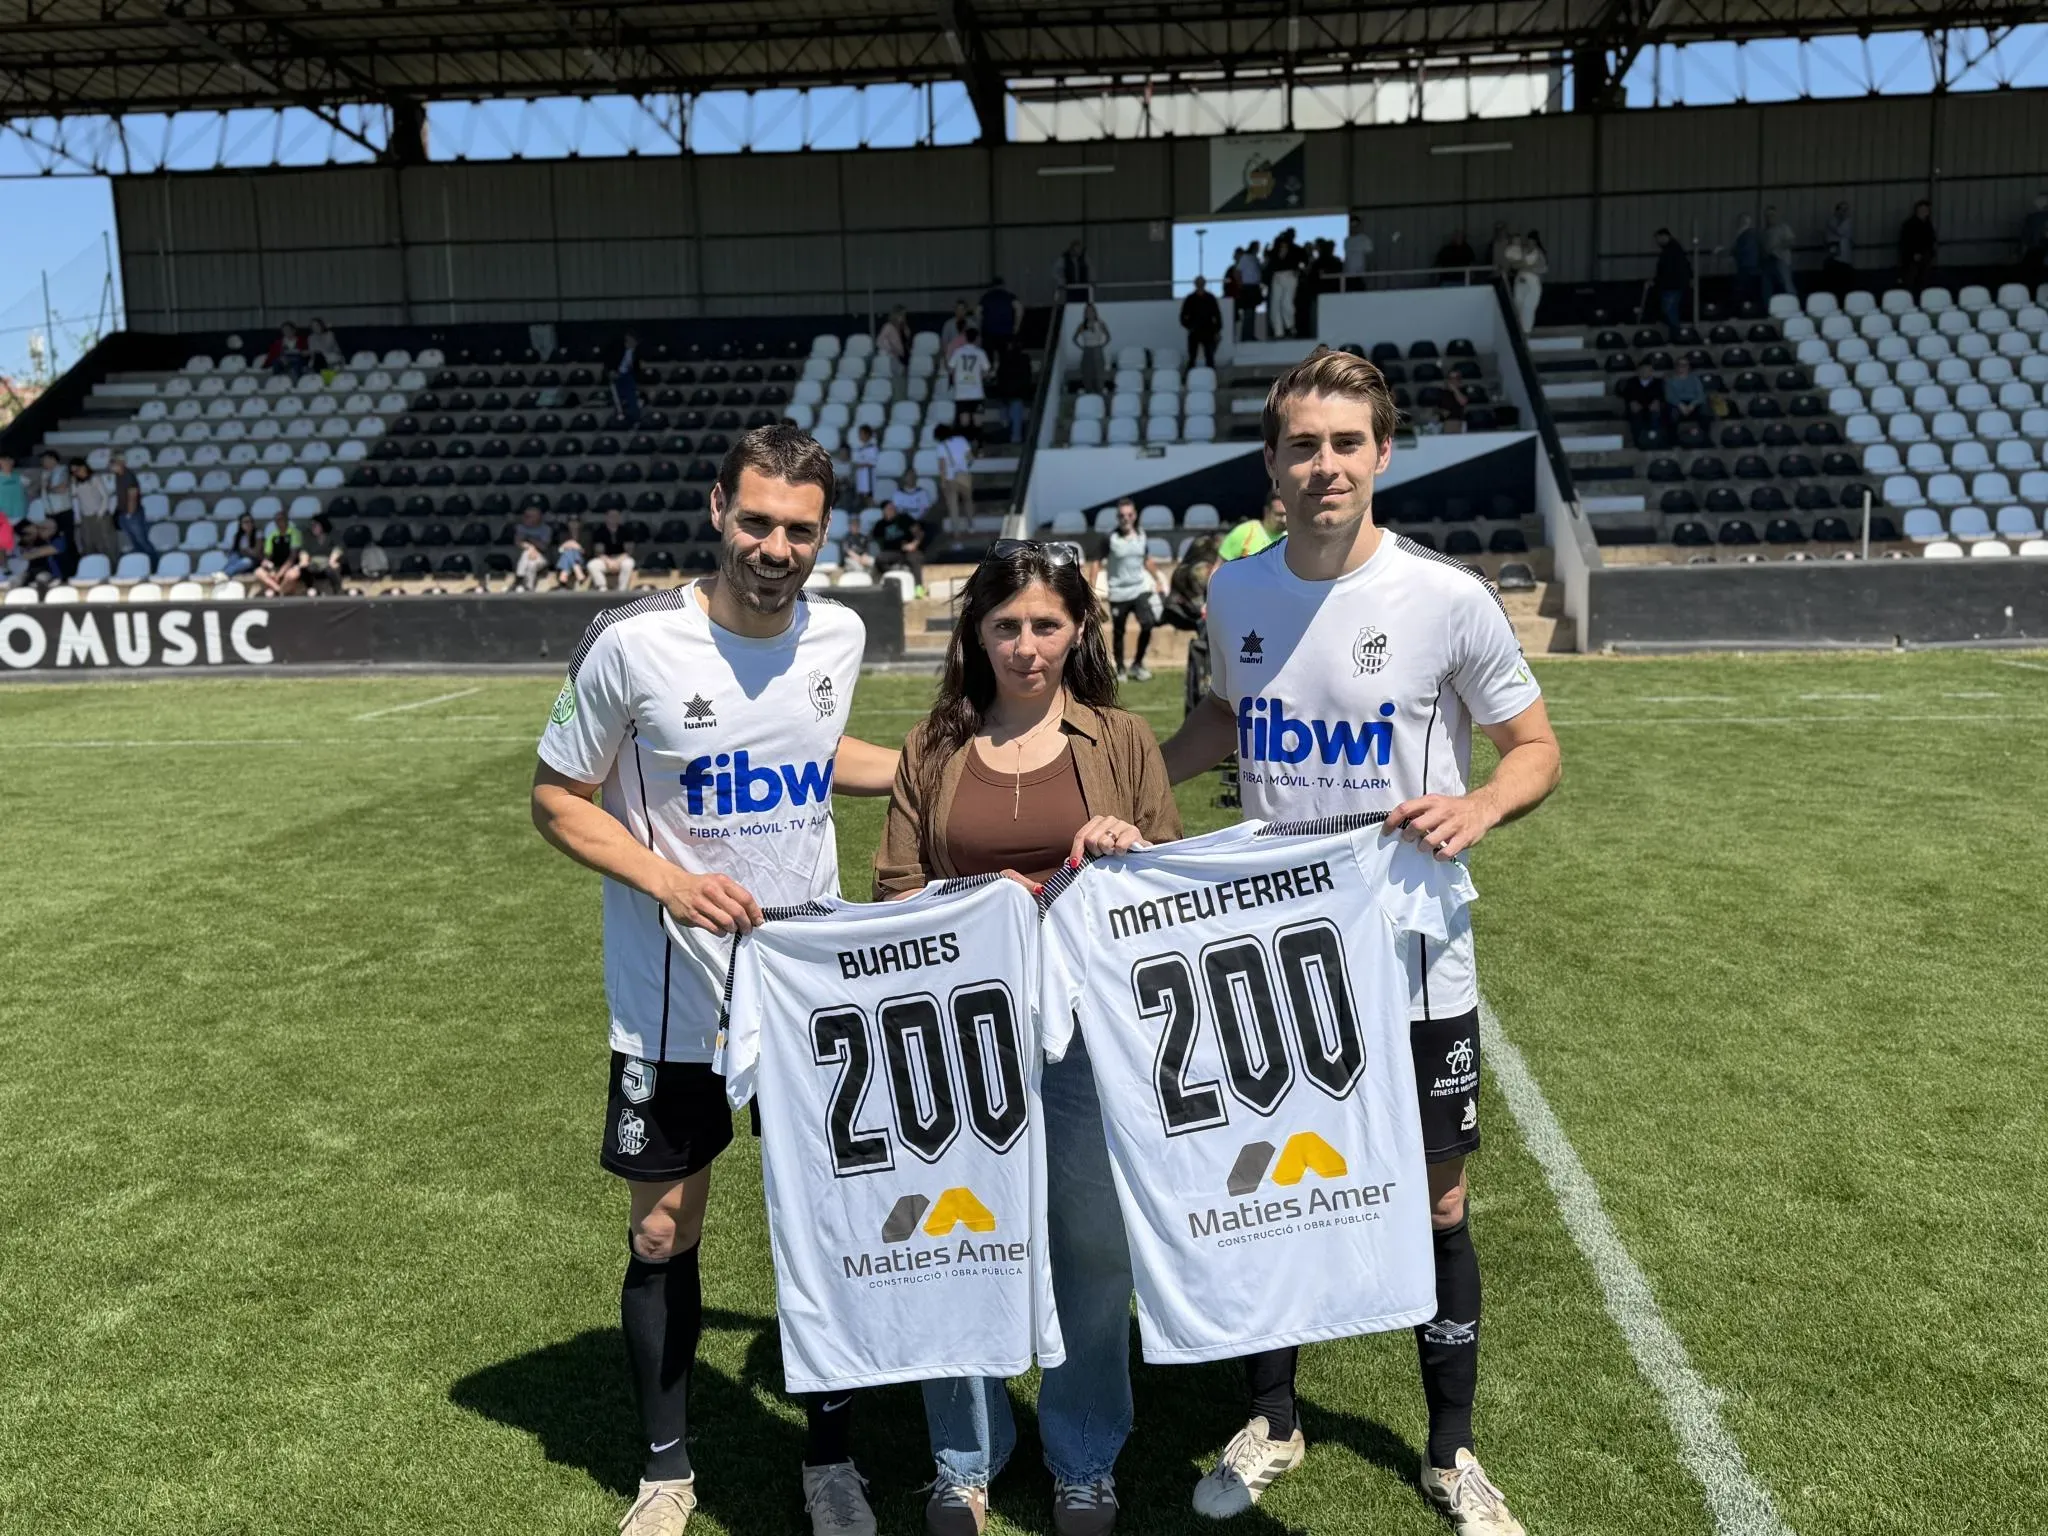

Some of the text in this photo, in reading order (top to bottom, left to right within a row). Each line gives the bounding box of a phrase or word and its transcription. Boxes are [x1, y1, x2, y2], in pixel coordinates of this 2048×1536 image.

[961, 354, 978, 372] 17
[0, 609, 273, 668] OMUSIC
[1240, 656, 1263, 664] luanvi
[684, 719, 717, 729] luanvi
[1238, 696, 1396, 766] fibwi
[1269, 773, 1309, 787] MÓVIL
[1317, 777, 1334, 788] TV
[1343, 778, 1391, 790] ALARM
[690, 827, 730, 839] FIBRA
[740, 822, 782, 837] MÓVIL
[790, 819, 805, 831] TV
[837, 932, 960, 979] BUADES
[1131, 917, 1367, 1138] 200
[809, 978, 1029, 1179] 200
[1188, 1182, 1396, 1239] Maties Amer
[1217, 1226, 1294, 1248] CONSTRUCCIÓ
[1304, 1219, 1331, 1231] OBRA
[843, 1247, 951, 1279] Maties
[869, 1271, 942, 1289] CONSTRUCCIÓ
[952, 1268, 978, 1277] OBRA
[981, 1266, 1023, 1276] PÚBLICA
